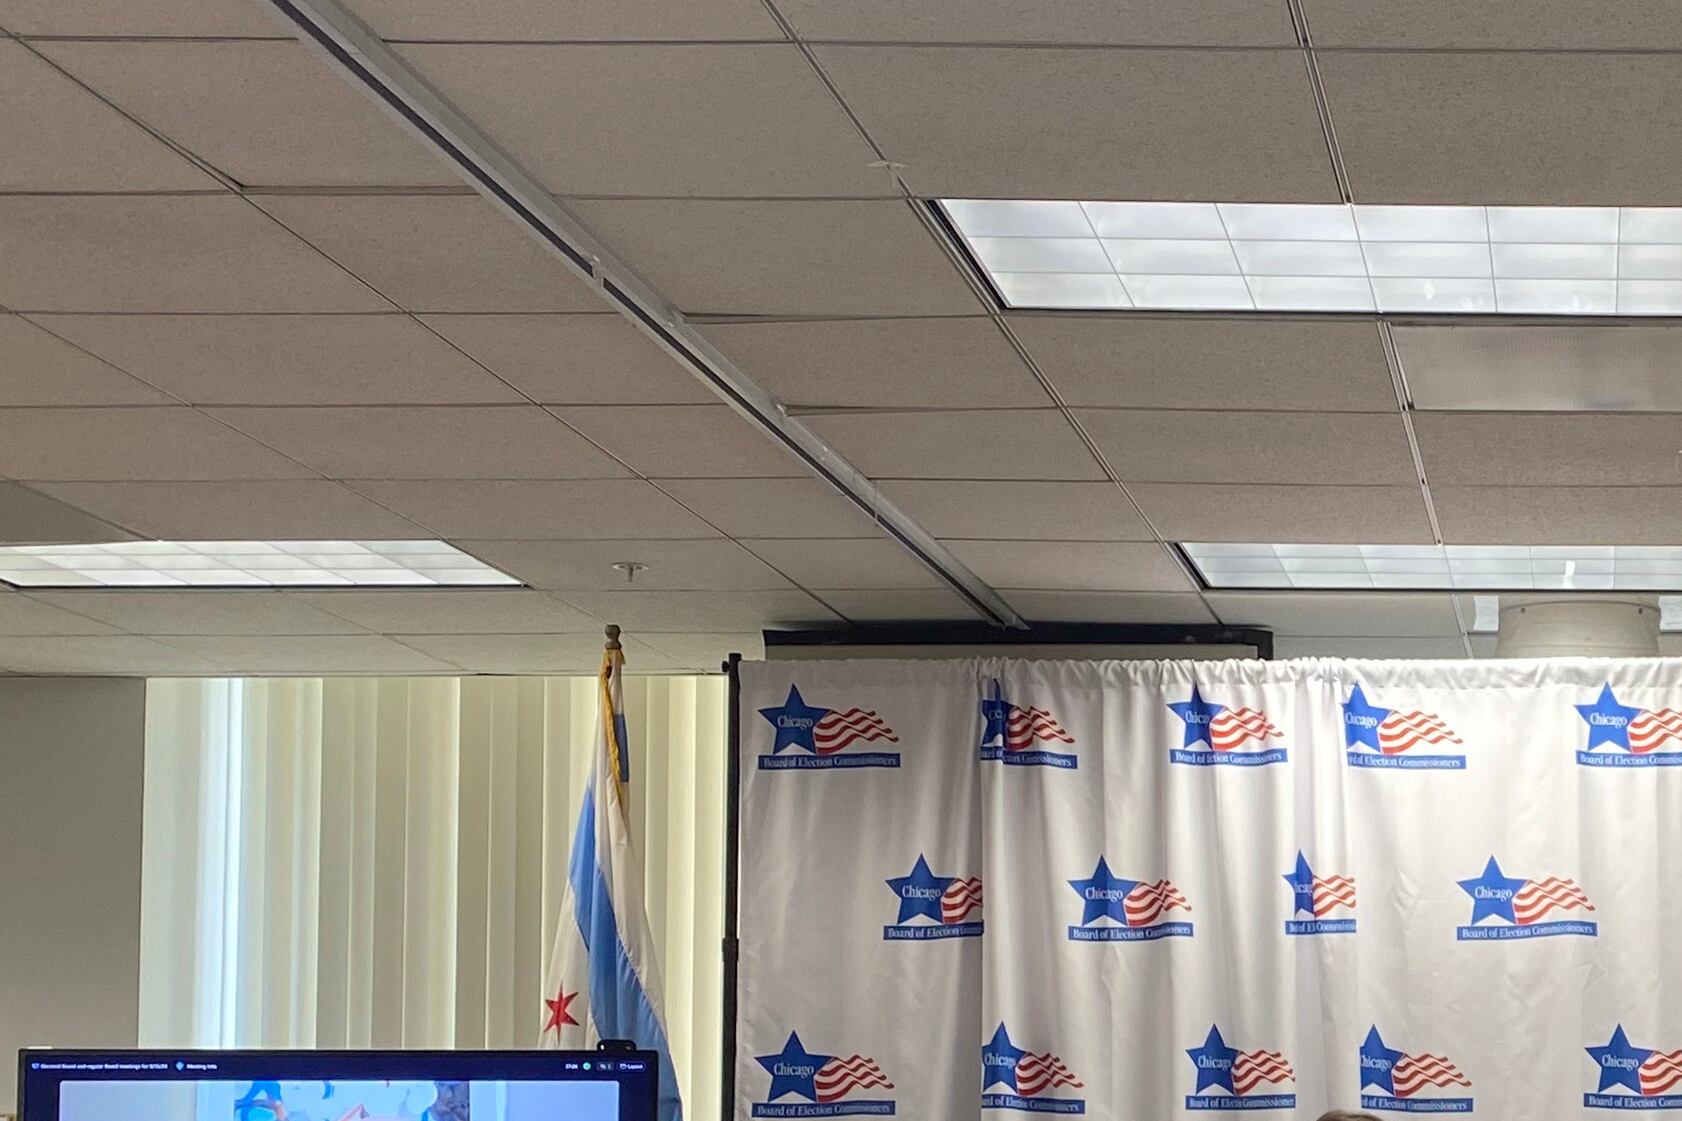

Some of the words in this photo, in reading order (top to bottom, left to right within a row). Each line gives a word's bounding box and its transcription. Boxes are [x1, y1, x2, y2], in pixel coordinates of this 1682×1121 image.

[777, 714, 813, 730] Chicago
[1590, 712, 1628, 728] Chicago
[1580, 754, 1604, 766] Board
[1604, 754, 1613, 766] of
[1614, 755, 1648, 766] Election
[902, 885, 942, 900] Chicago
[1085, 887, 1123, 902] Chicago
[1475, 887, 1512, 902] Chicago
[888, 928, 914, 938] Board
[1073, 930, 1099, 940] Board
[1100, 930, 1109, 940] of
[1110, 928, 1144, 940] Election
[1462, 928, 1488, 938] Board
[1489, 927, 1498, 938] of
[1499, 926, 1532, 938] Election
[1532, 924, 1593, 936] Commissioners
[1197, 1054, 1232, 1070] Chicago
[1602, 1055, 1639, 1071] Chicago
[774, 1062, 814, 1078] Chicago
[1407, 1100, 1468, 1110] Commissioners
[1588, 1096, 1613, 1106] Board
[1614, 1096, 1623, 1108] of
[1624, 1096, 1657, 1108] Election
[758, 1105, 784, 1116] Board
[786, 1105, 796, 1116] of
[798, 1105, 832, 1116] Election
